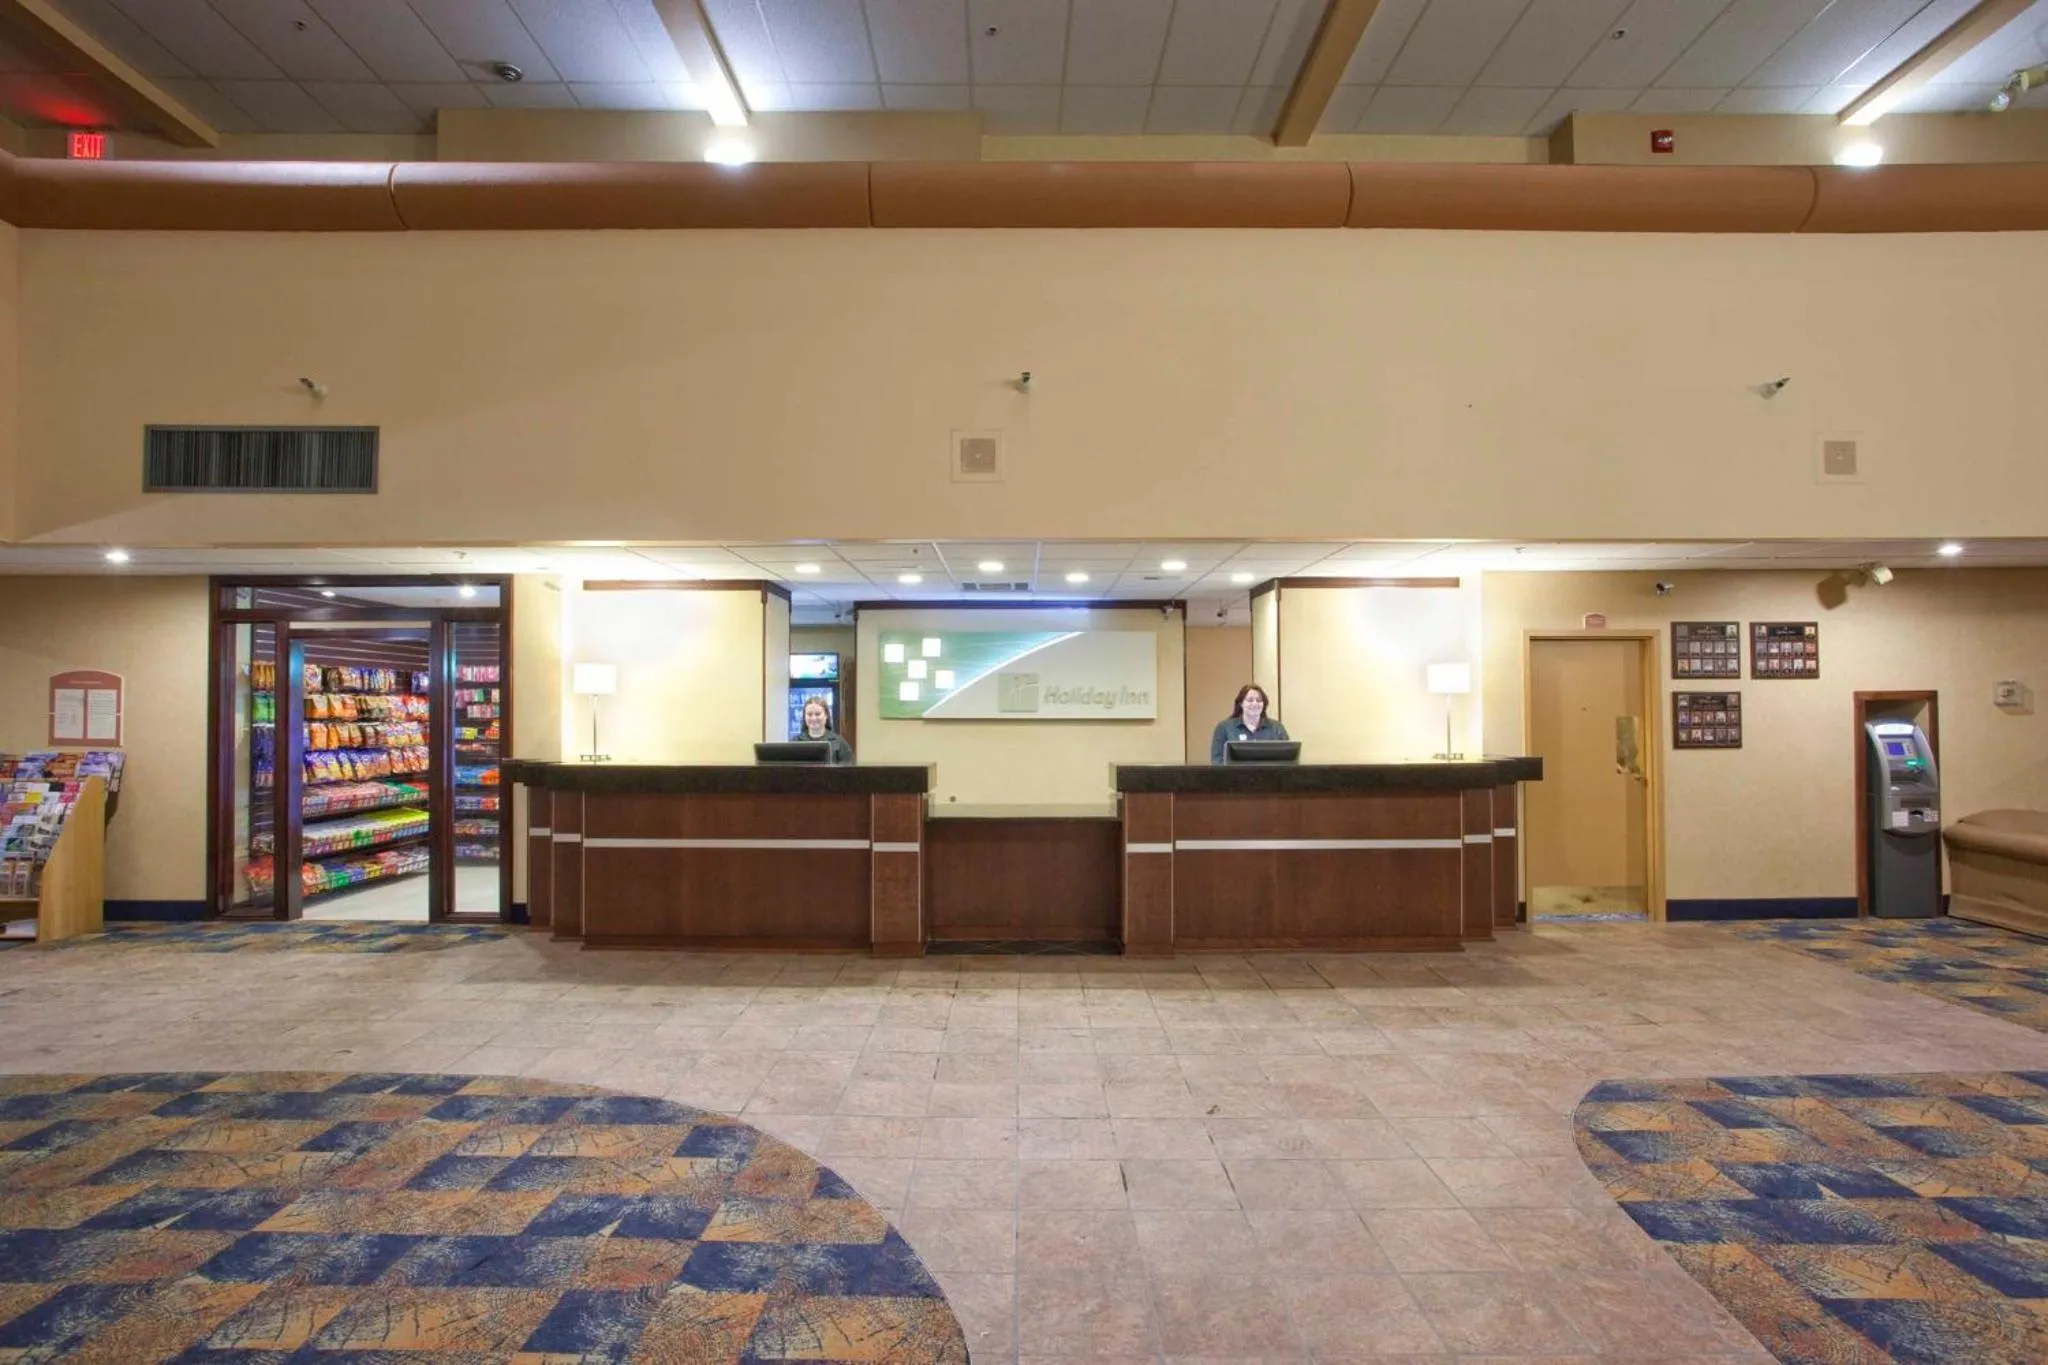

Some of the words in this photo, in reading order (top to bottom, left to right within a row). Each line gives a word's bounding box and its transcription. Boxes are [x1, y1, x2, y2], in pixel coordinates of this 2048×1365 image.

[73, 134, 104, 158] EXIT
[1044, 685, 1117, 709] Holiday
[1119, 685, 1149, 705] Inn
